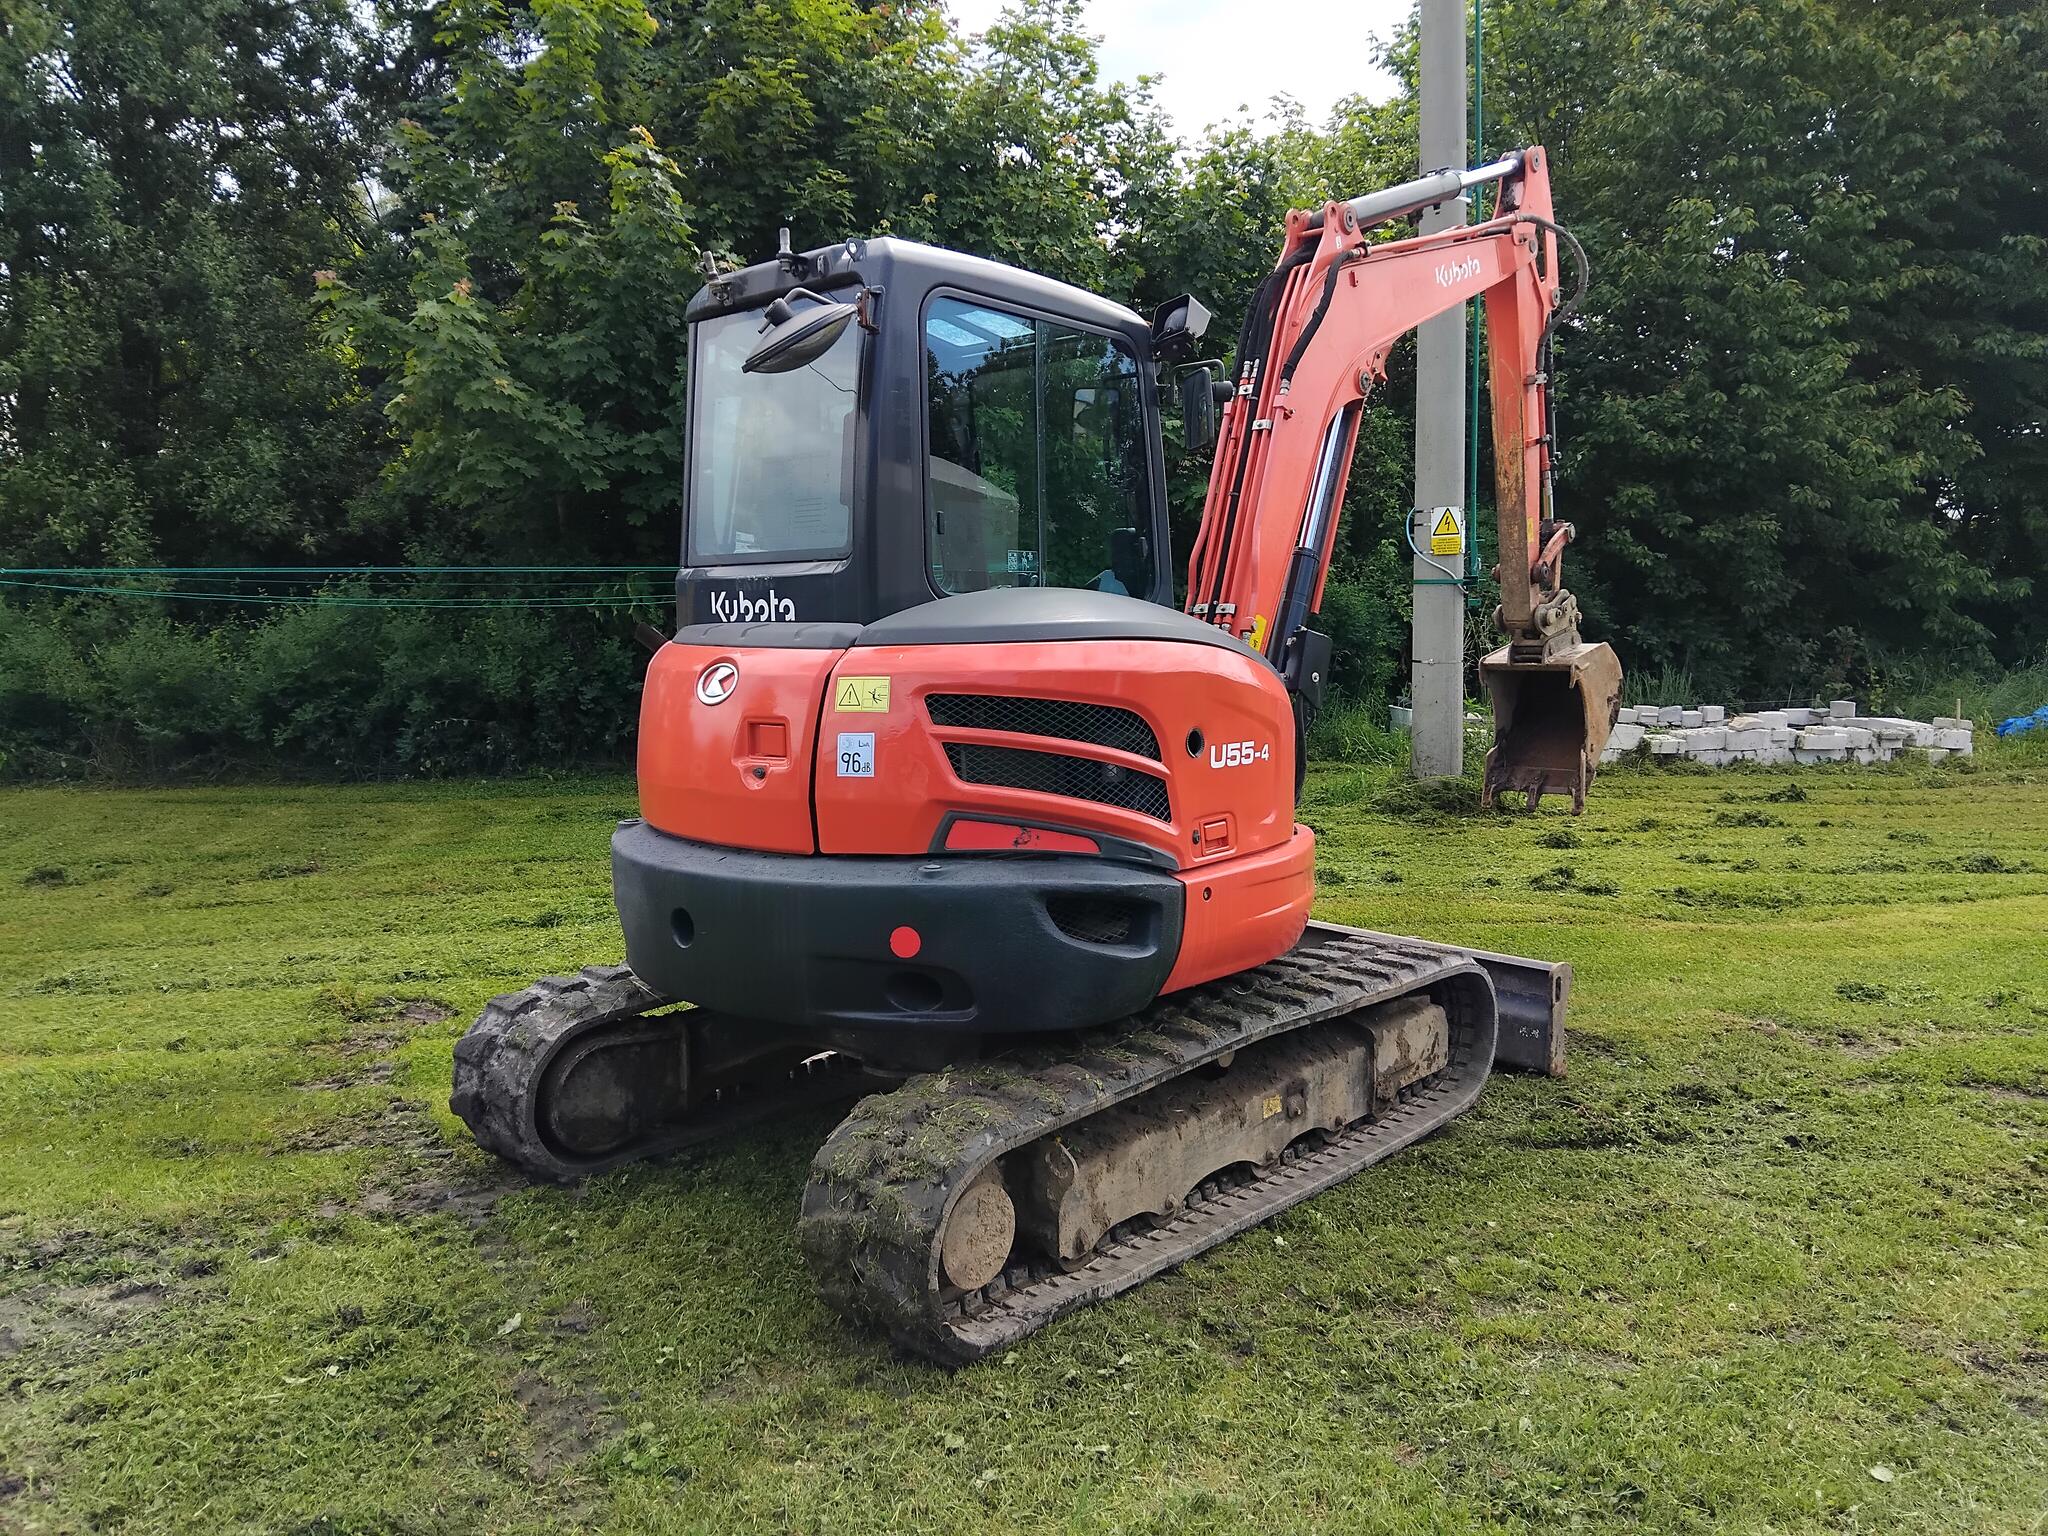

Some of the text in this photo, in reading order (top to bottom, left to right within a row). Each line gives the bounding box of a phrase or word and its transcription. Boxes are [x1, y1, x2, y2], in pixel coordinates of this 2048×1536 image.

[1435, 255, 1481, 287] Kubota
[710, 589, 795, 622] Kubota
[1210, 741, 1269, 769] U55-4
